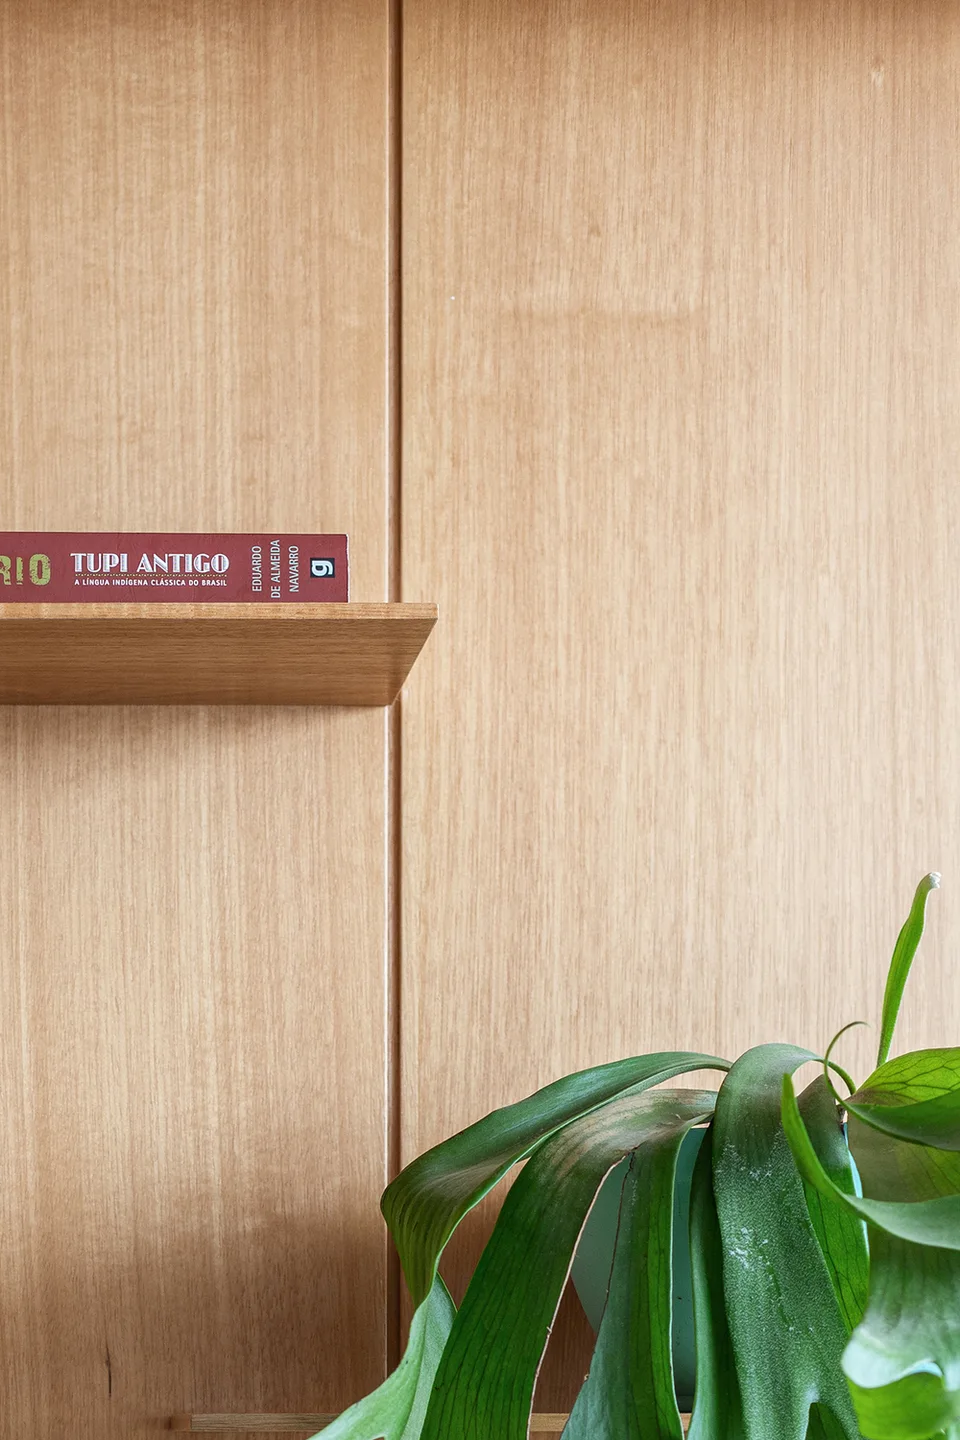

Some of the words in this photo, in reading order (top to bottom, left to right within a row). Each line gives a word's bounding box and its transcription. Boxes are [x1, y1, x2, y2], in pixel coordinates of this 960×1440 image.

[70, 553, 129, 573] TUPI
[136, 553, 230, 574] ANTIGO
[251, 545, 262, 592] EDUARDO
[270, 539, 281, 583] ALMEIDA
[288, 545, 300, 593] NAVARRO
[82, 577, 110, 586] LÍNGUA
[112, 577, 148, 586] INDÍGENA
[150, 577, 186, 587] CLÁSSICA
[188, 579, 199, 587] DO
[201, 579, 228, 587] BRASIL
[270, 585, 281, 599] DE
